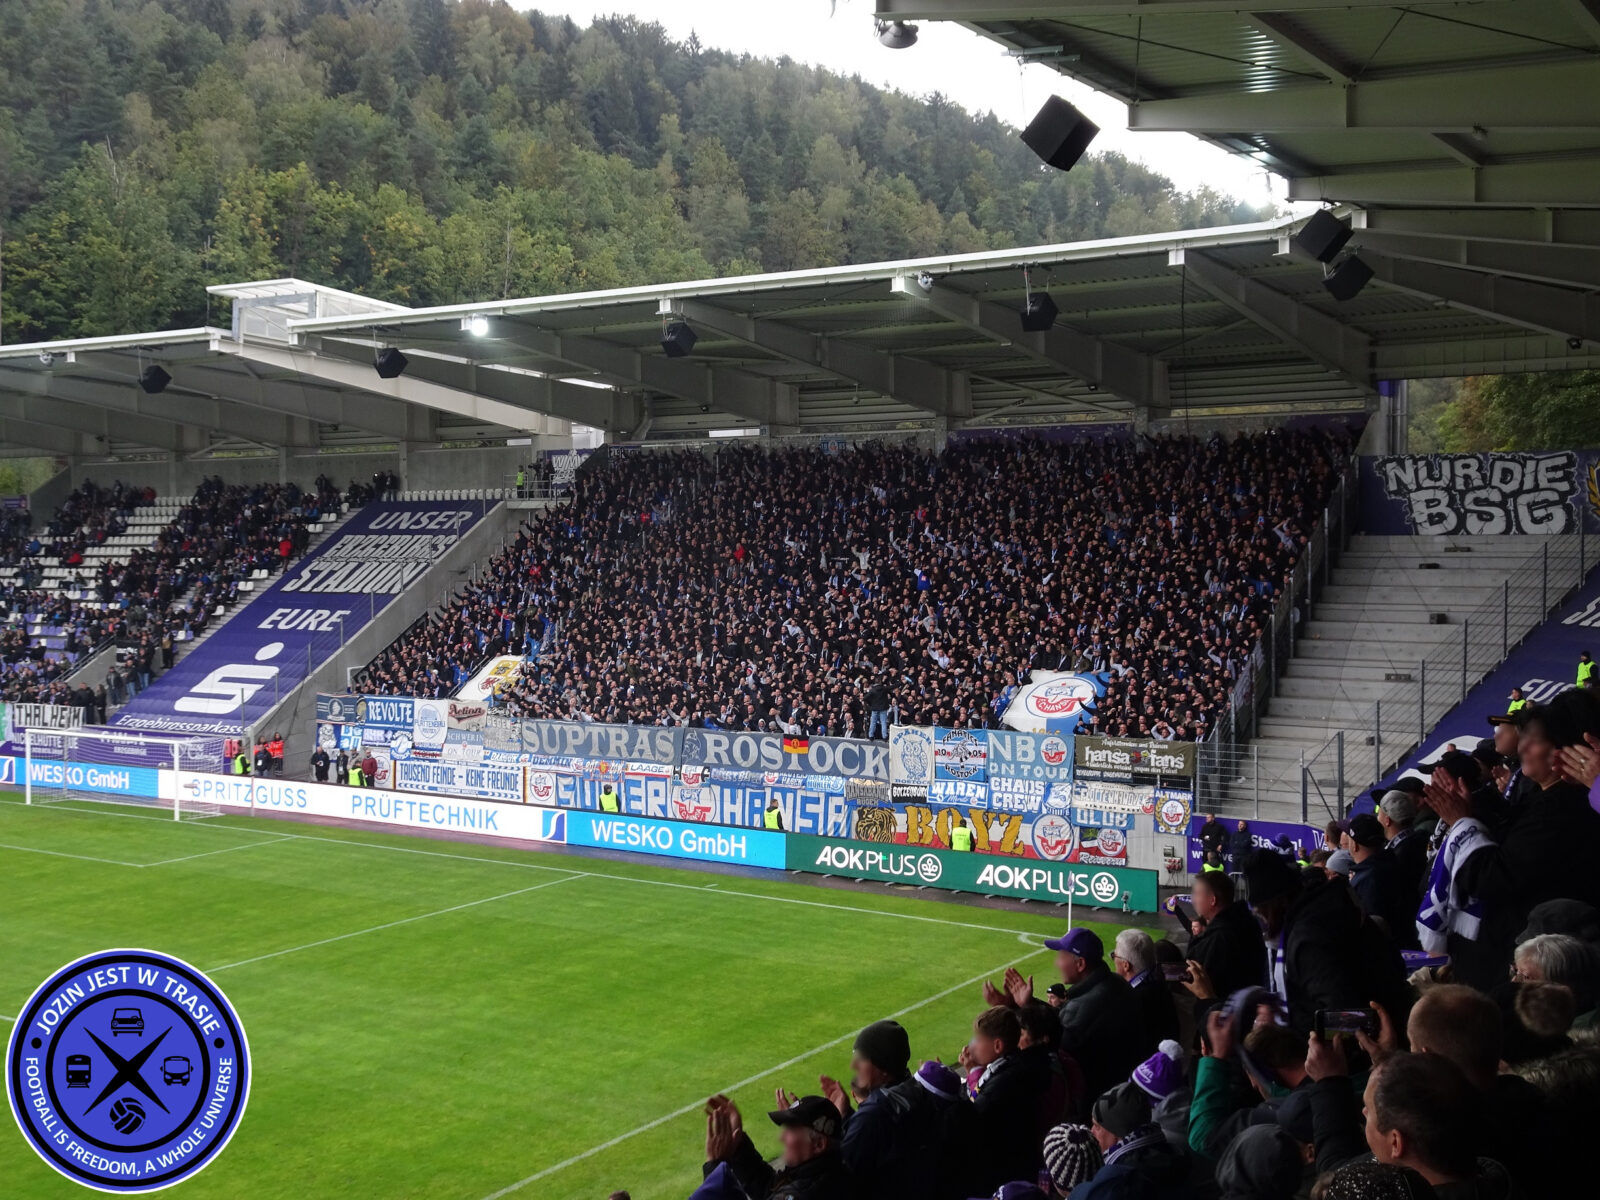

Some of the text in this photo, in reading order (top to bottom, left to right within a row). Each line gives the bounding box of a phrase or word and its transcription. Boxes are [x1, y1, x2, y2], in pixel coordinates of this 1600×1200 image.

[1386, 454, 1571, 493] NUR DIE
[369, 512, 473, 530] UNSER
[1409, 488, 1568, 535] BSG
[257, 608, 351, 632] EURE
[367, 701, 414, 723] REVOLTE
[522, 721, 675, 764] SUPTRAS
[988, 732, 1036, 763] NB
[630, 762, 665, 773] LAAGE
[1085, 746, 1185, 770] hansa fans
[30, 764, 129, 790] WESKO GmbH
[400, 763, 430, 783] TAUSEND
[432, 766, 456, 786] FEINDE
[465, 768, 485, 788] KEINE
[487, 770, 519, 792] FREUNDE
[989, 762, 1015, 776] ON
[1020, 764, 1069, 780] TOUR
[192, 778, 307, 808] SPRITZGUSS
[930, 781, 986, 799] WAREN
[990, 777, 1045, 795] CHAOS
[1155, 790, 1193, 801] ALTMARK
[351, 793, 499, 831] PRÜFTECHNIK
[991, 793, 1043, 812] CREW
[591, 819, 746, 858] WESKO GmbH
[904, 804, 1025, 856] BOYZ
